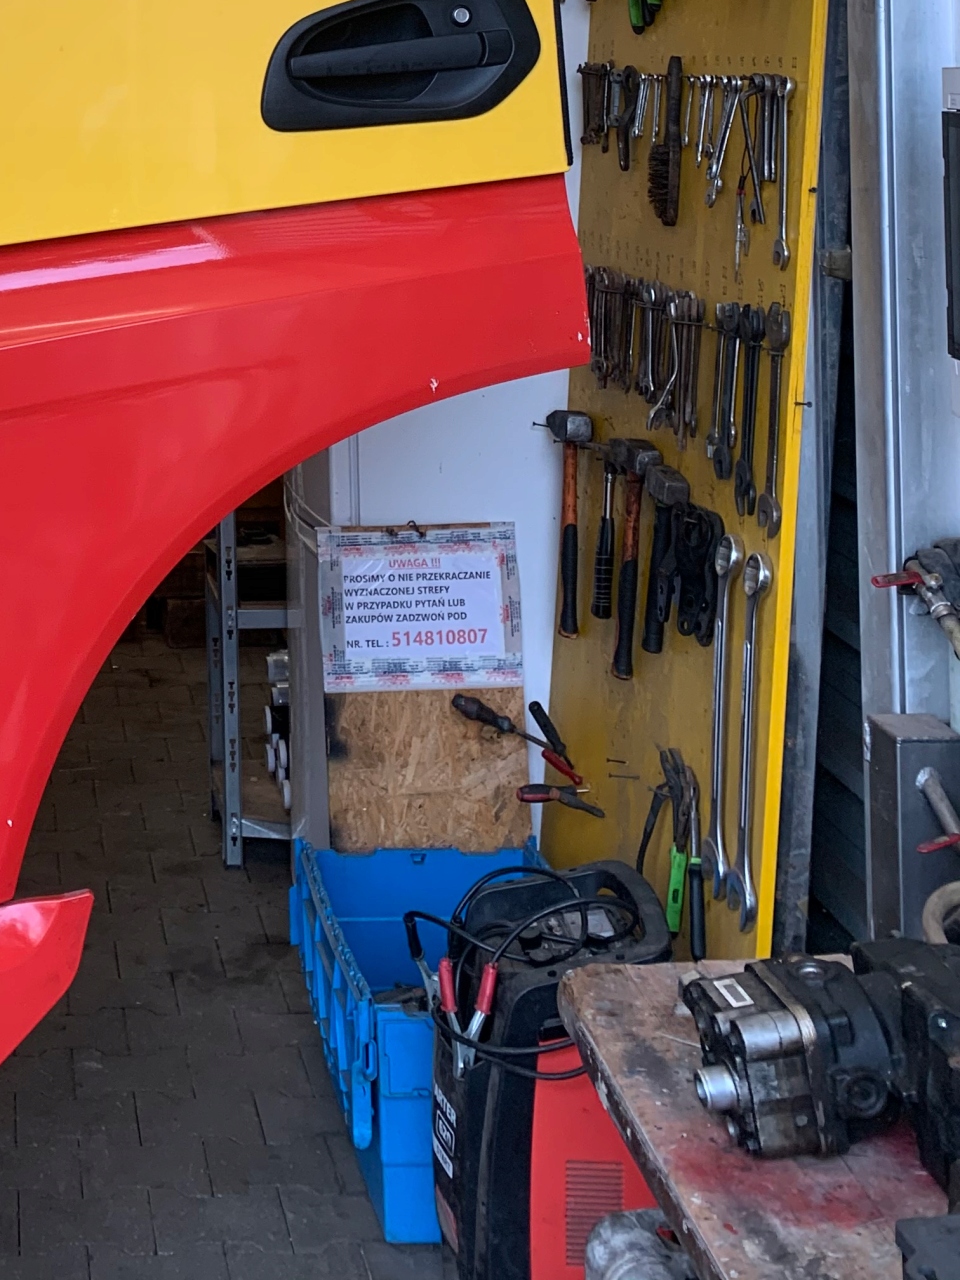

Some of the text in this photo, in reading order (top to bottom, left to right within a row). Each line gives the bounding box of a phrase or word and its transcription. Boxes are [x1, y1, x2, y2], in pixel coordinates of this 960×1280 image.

[389, 558, 441, 568] UWAGA !!!
[344, 571, 491, 584] PROSIMY O NIE PRZEKRACZANIE
[344, 586, 450, 597] WYZNACZONEJ STREFY
[345, 597, 465, 610] W PRZYPADKU PYTAŃ LUB
[346, 611, 467, 623] ZAKUPÓW ZADZWOŃ POD
[347, 640, 363, 648] NR.
[392, 629, 487, 647] 514810807
